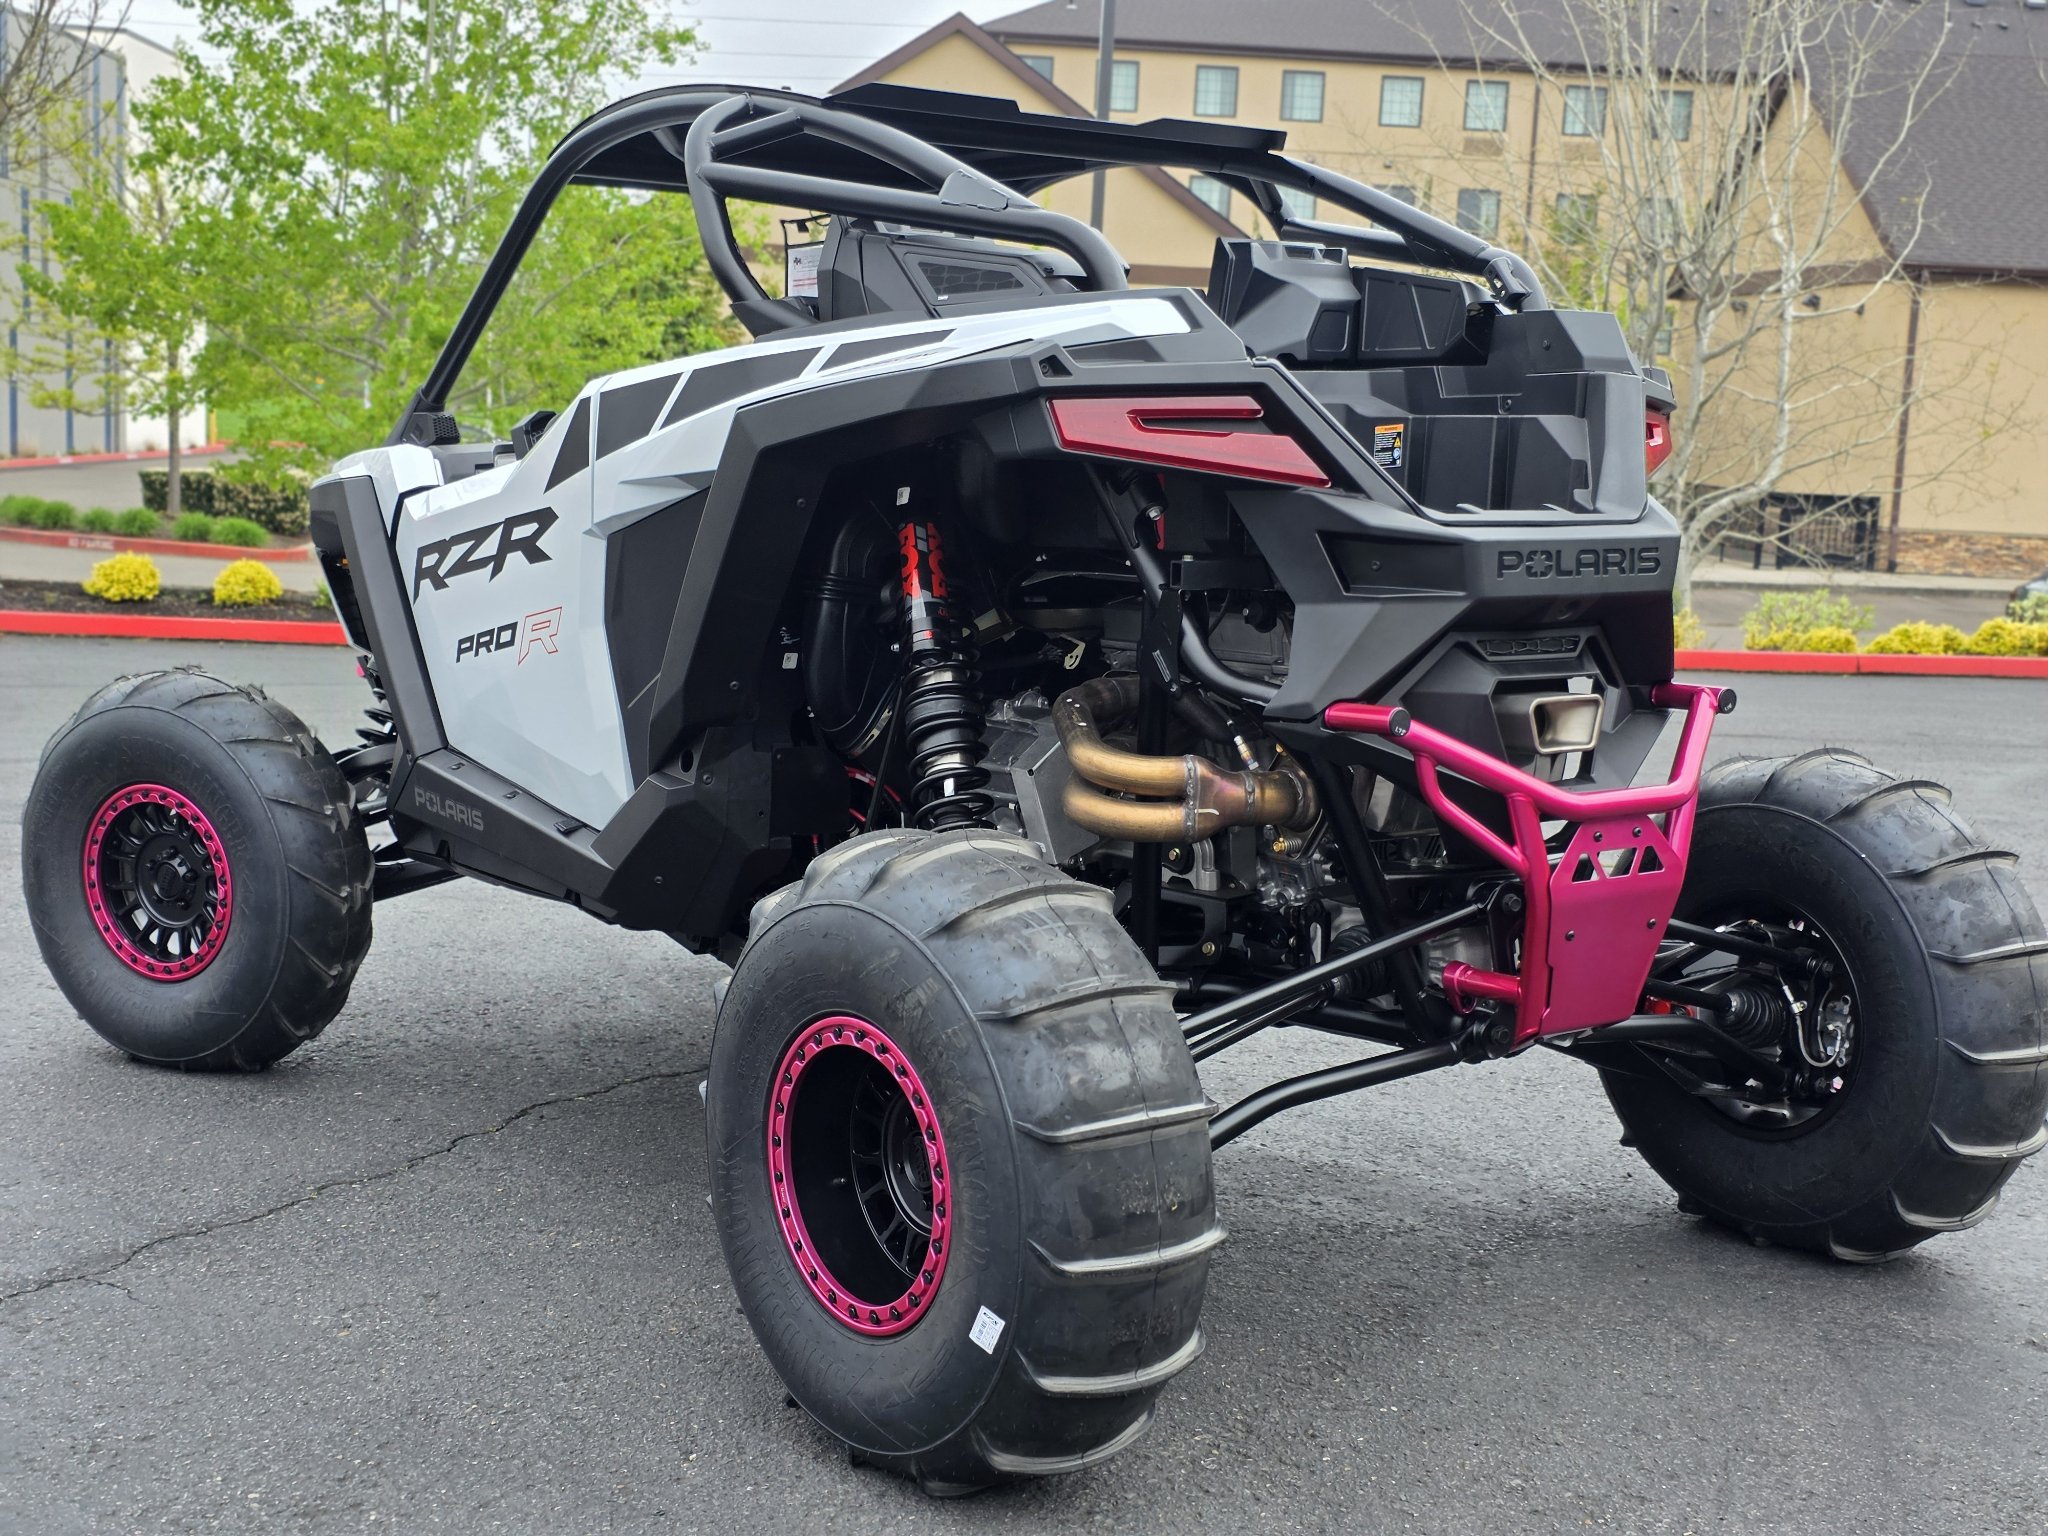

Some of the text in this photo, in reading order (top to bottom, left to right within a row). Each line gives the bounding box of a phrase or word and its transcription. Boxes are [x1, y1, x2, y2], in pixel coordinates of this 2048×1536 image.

[413, 506, 559, 606] RZR
[1496, 547, 1661, 580] POLARIS
[456, 606, 562, 667] PRO R
[414, 785, 484, 831] POLARIS
